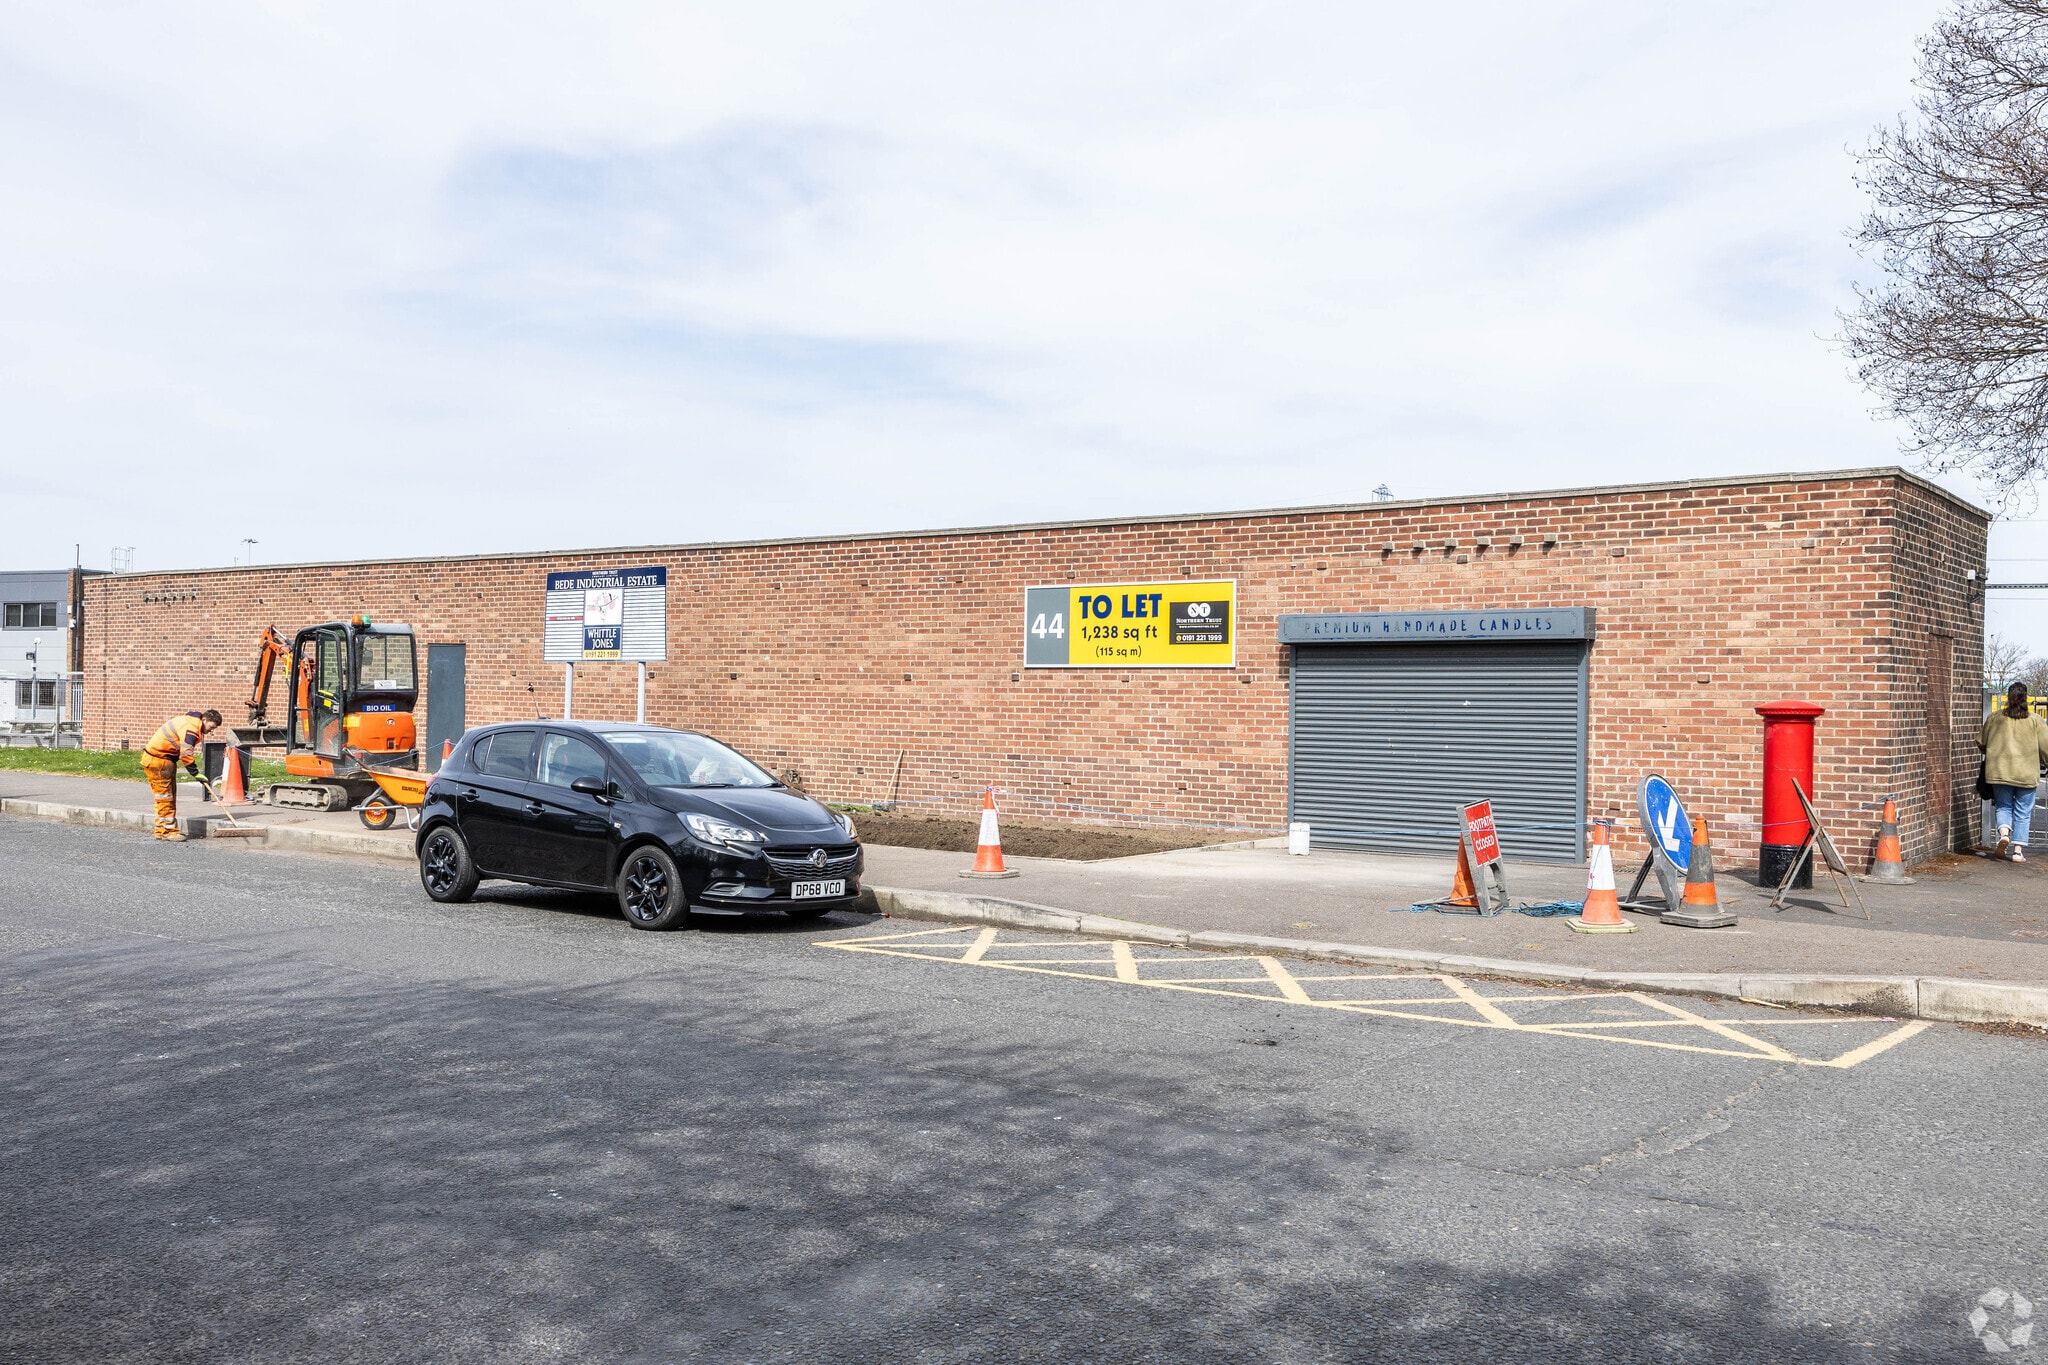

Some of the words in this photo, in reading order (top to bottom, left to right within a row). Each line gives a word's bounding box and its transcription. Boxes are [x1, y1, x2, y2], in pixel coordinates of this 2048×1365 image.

[555, 579, 575, 590] BEDE
[576, 577, 624, 588] INDUSTRIAL
[627, 575, 657, 586] ESTATE
[1078, 594, 1112, 619] TO
[1121, 593, 1162, 618] LET
[1031, 613, 1065, 639] 44
[1081, 625, 1118, 641] 1,238
[1123, 627, 1139, 641] sq
[1145, 624, 1158, 639] ft
[1304, 621, 1372, 634] PREMIUM
[1383, 619, 1467, 634] HANDMADE
[1479, 617, 1552, 631] CANDLES
[587, 628, 617, 639] WHITTLE
[1182, 634, 1195, 642] 0191
[592, 638, 614, 650] JONES
[1095, 645, 1113, 658] (115
[1116, 647, 1128, 657] sq
[1130, 645, 1142, 658] m)
[366, 704, 379, 712] BIO
[380, 704, 392, 712] OIL
[1475, 834, 1495, 851] CLOSED
[796, 884, 821, 896] DP68
[824, 882, 841, 894] VCO
